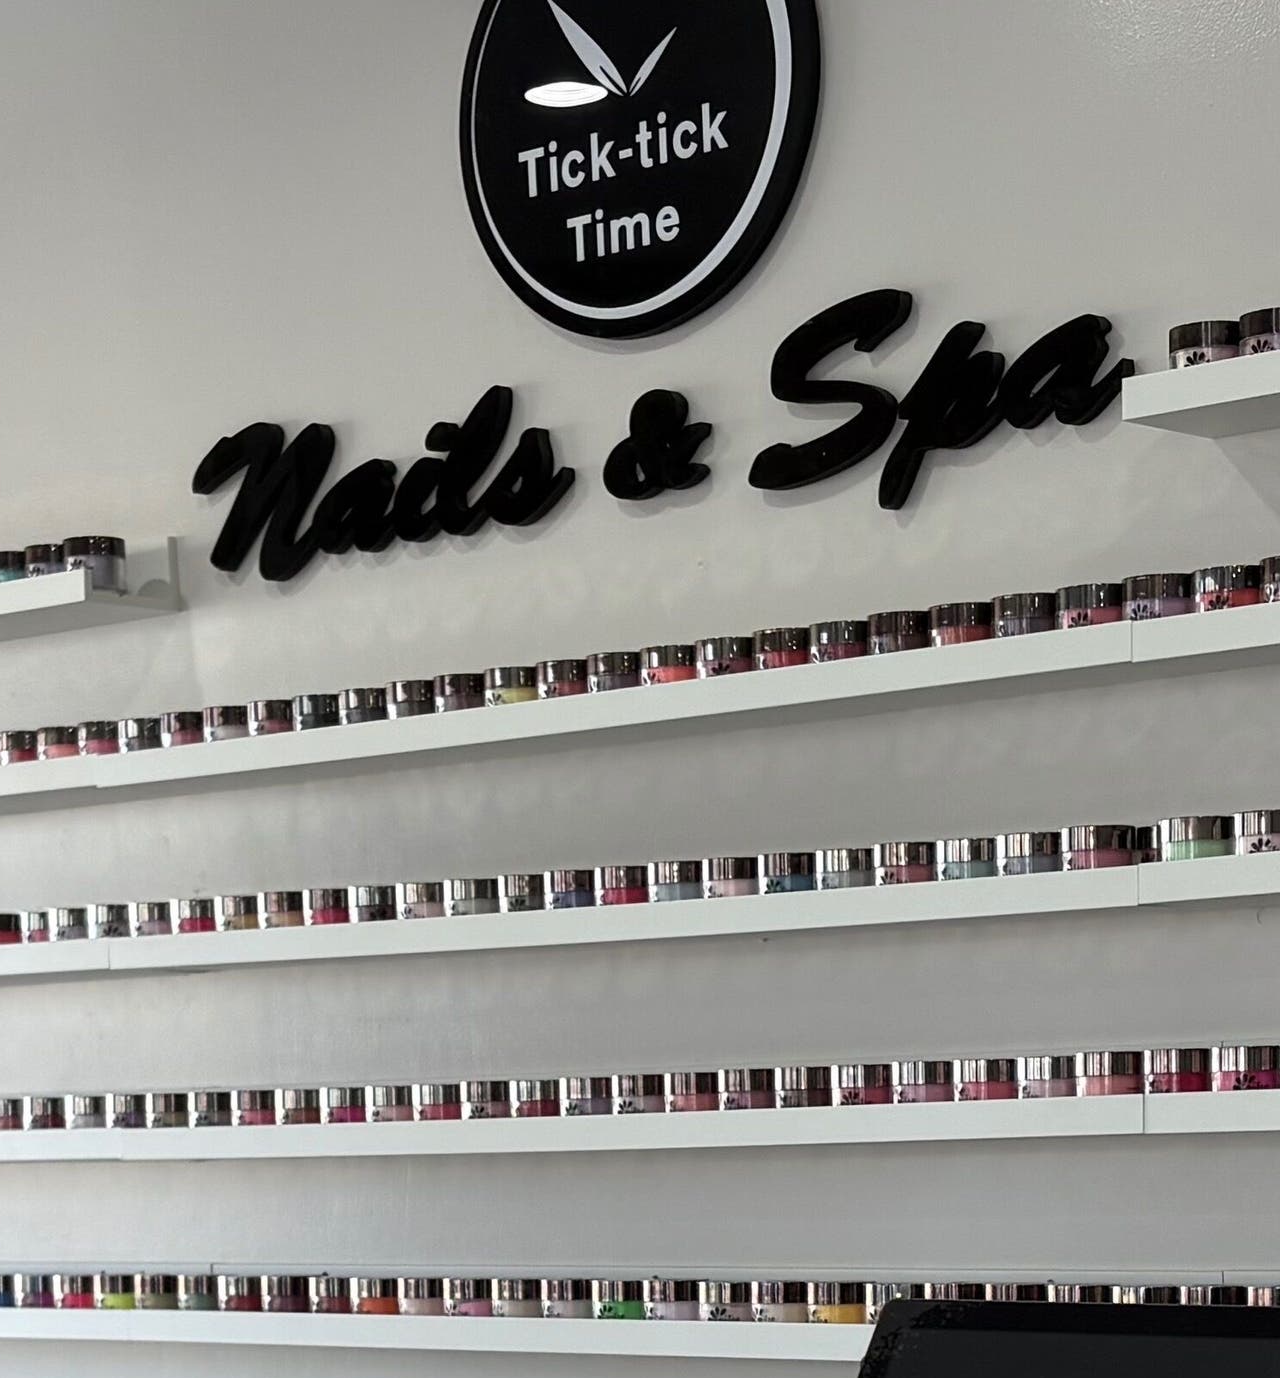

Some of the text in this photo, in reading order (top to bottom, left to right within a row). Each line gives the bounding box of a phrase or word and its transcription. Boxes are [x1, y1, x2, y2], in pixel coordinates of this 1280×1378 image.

[518, 102, 729, 198] Tick-tick
[566, 205, 681, 263] Time
[192, 288, 1135, 581] Nails & Spa
